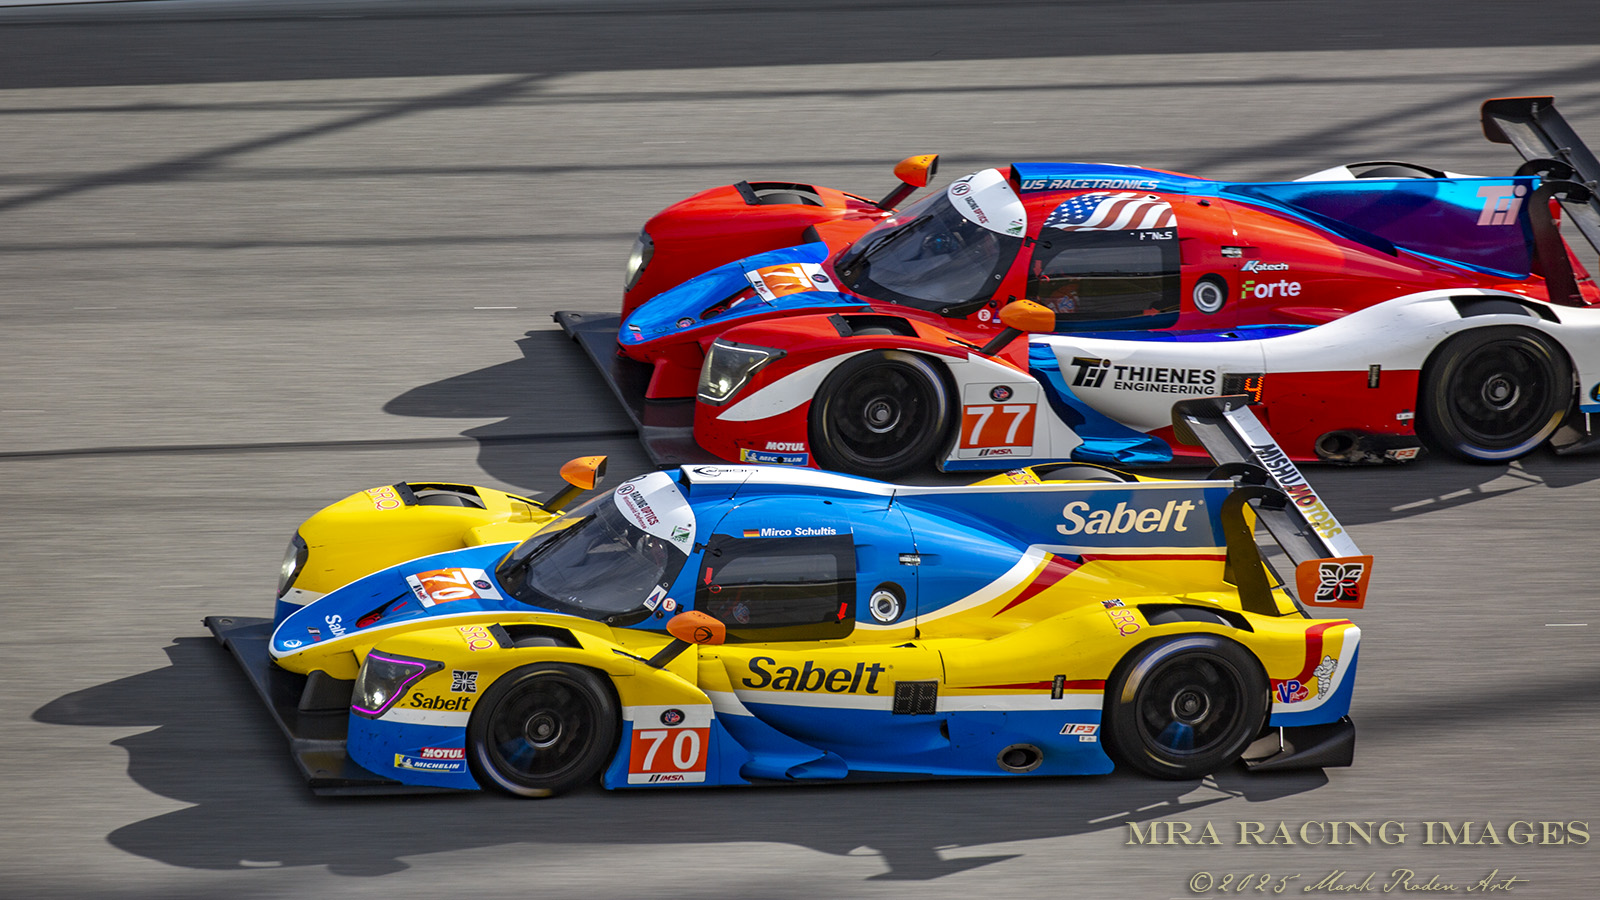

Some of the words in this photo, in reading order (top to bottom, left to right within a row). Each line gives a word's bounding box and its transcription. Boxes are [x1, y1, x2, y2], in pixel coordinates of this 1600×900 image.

[1022, 179, 1048, 191] US
[1048, 179, 1160, 191] RACETRONICS
[1240, 260, 1290, 274] Katech
[1241, 279, 1302, 299] Forte
[1114, 365, 1216, 385] THIENES
[1114, 381, 1216, 396] ENGINEERING
[966, 405, 1031, 446] 77
[765, 441, 805, 452] MOTUL
[758, 455, 803, 463] MICELIN
[1251, 443, 1302, 485] MISHU
[1283, 483, 1342, 539] MOTORS
[630, 490, 649, 508] RACING
[641, 505, 660, 526] OPTICS
[1056, 499, 1196, 536] Sabelt
[761, 528, 793, 537] Mirco
[795, 527, 837, 537] Schultis
[421, 571, 475, 600] 70
[325, 614, 347, 638] Sab
[1110, 609, 1141, 637] SRQ
[460, 626, 494, 652] SRQ
[742, 656, 887, 695] Sabelt
[410, 692, 472, 711] Sabelt
[1277, 680, 1301, 704] VP
[1074, 725, 1096, 733] P3
[422, 748, 464, 759] MOTUL
[639, 729, 701, 771] 70
[413, 761, 461, 770] MICHELIN
[659, 774, 686, 782] IMSA
